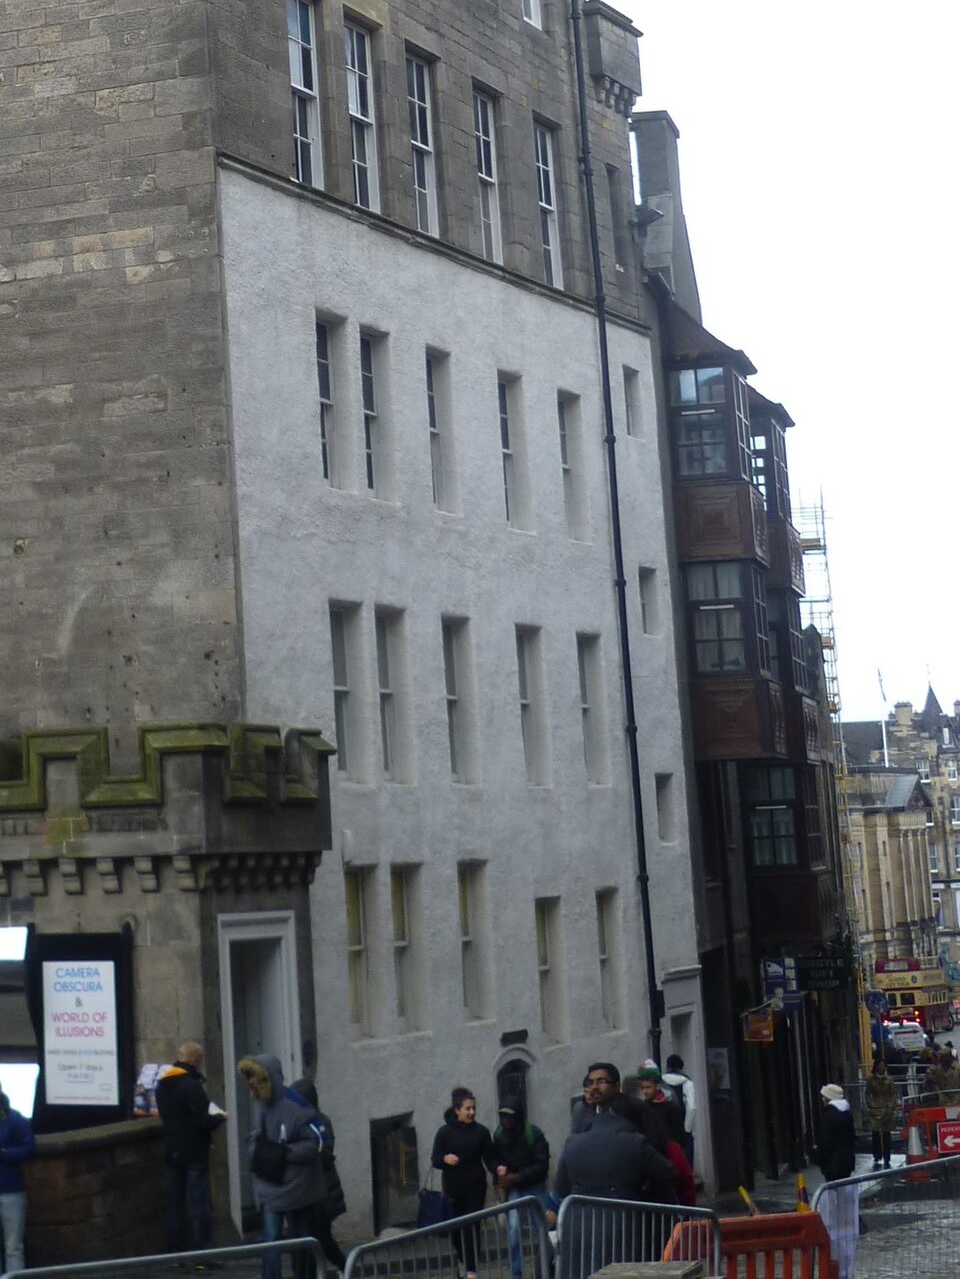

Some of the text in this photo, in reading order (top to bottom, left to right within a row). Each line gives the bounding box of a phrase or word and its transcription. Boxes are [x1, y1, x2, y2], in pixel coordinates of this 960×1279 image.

[55, 967, 100, 979] CAMERA
[53, 981, 103, 993] OBSCURA
[74, 996, 83, 1008] &
[51, 1011, 107, 1023] WORLD OF
[55, 1026, 105, 1037] ILLUSIONS
